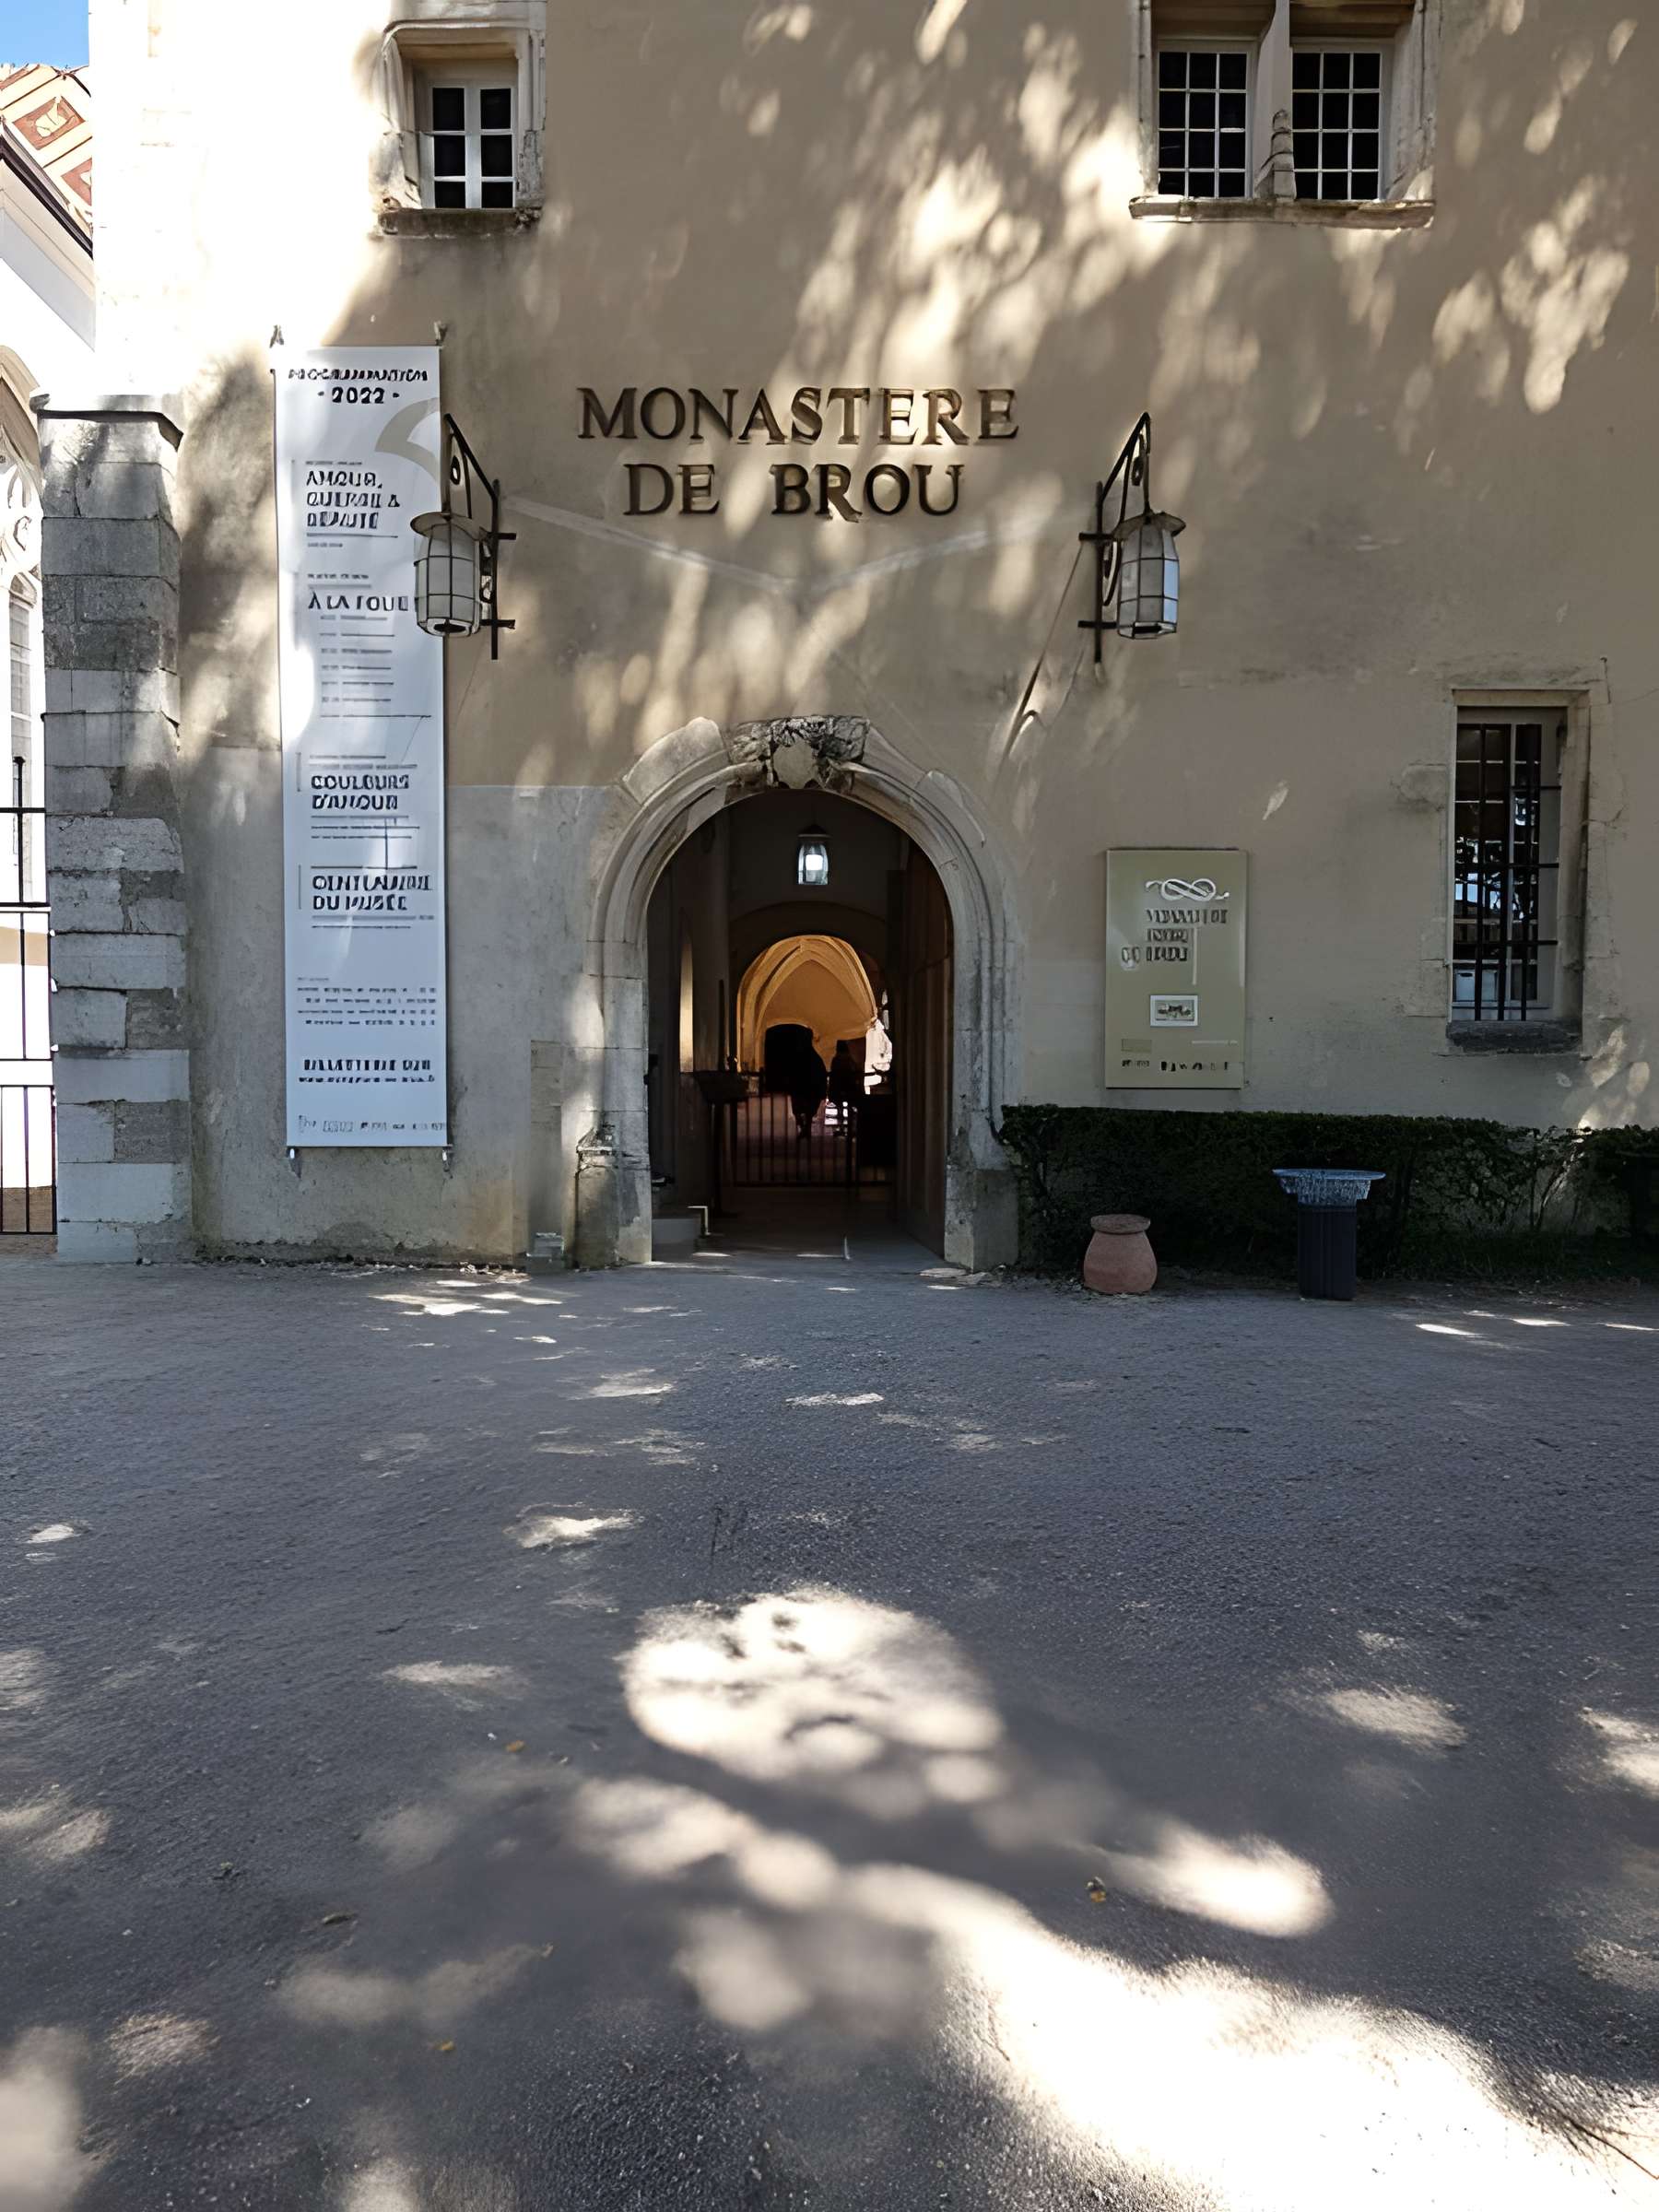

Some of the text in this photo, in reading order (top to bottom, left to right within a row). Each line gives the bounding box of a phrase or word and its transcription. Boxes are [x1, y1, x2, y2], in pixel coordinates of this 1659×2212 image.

[331, 386, 385, 404] 2022
[622, 463, 966, 523] DE BROU
[312, 895, 340, 911] DU
